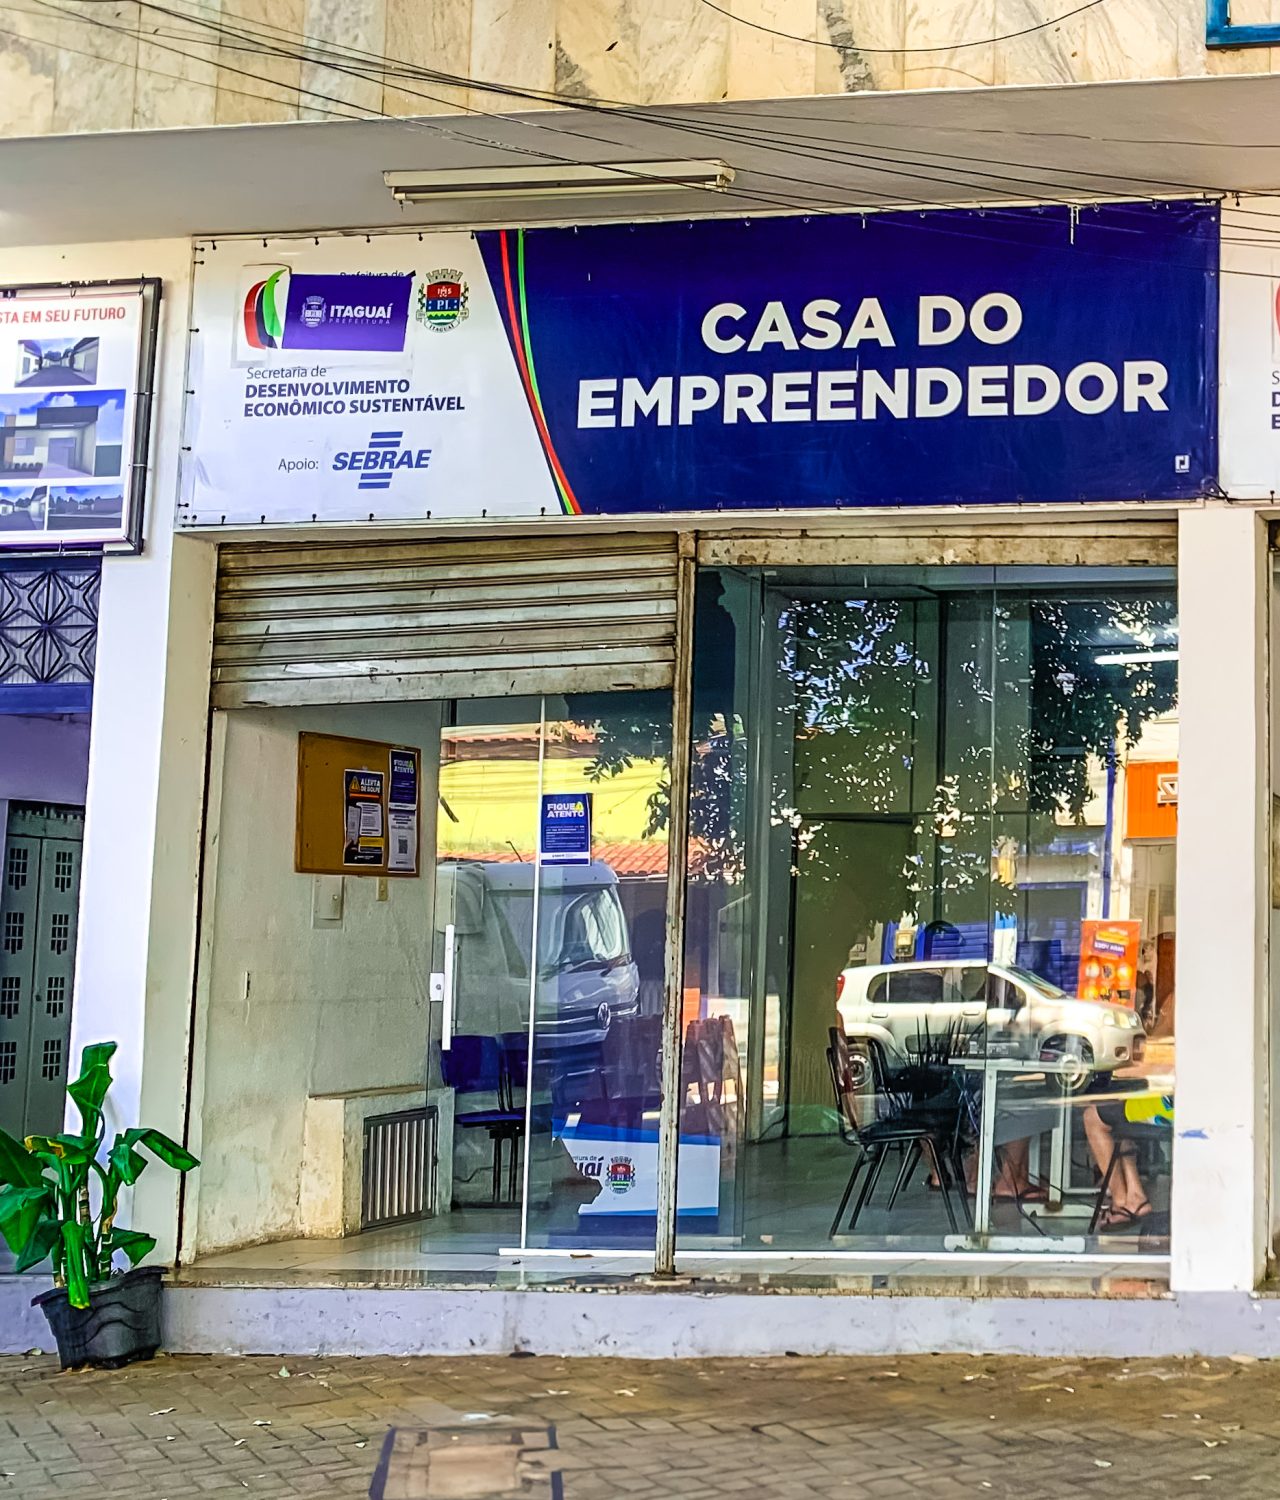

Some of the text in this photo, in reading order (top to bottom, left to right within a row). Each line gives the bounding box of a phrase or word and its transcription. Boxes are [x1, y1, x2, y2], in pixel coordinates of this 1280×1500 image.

[23, 310, 42, 323] EM
[45, 309, 70, 322] SEU
[74, 307, 126, 321] FUTURO
[329, 302, 393, 319] ITAGUAÍ
[701, 292, 1023, 354] CASA DO
[246, 365, 327, 380] Secretaria de
[245, 378, 410, 399] DESENVOLVIMENTO
[576, 360, 1170, 429] EMPREENDEDOR
[244, 393, 466, 418] ECONÔMICO SUSTENTÁVEL
[278, 449, 432, 474] Apoio: SEBRAE
[547, 802, 576, 811] FIQUE
[547, 810, 585, 818] ATENTO
